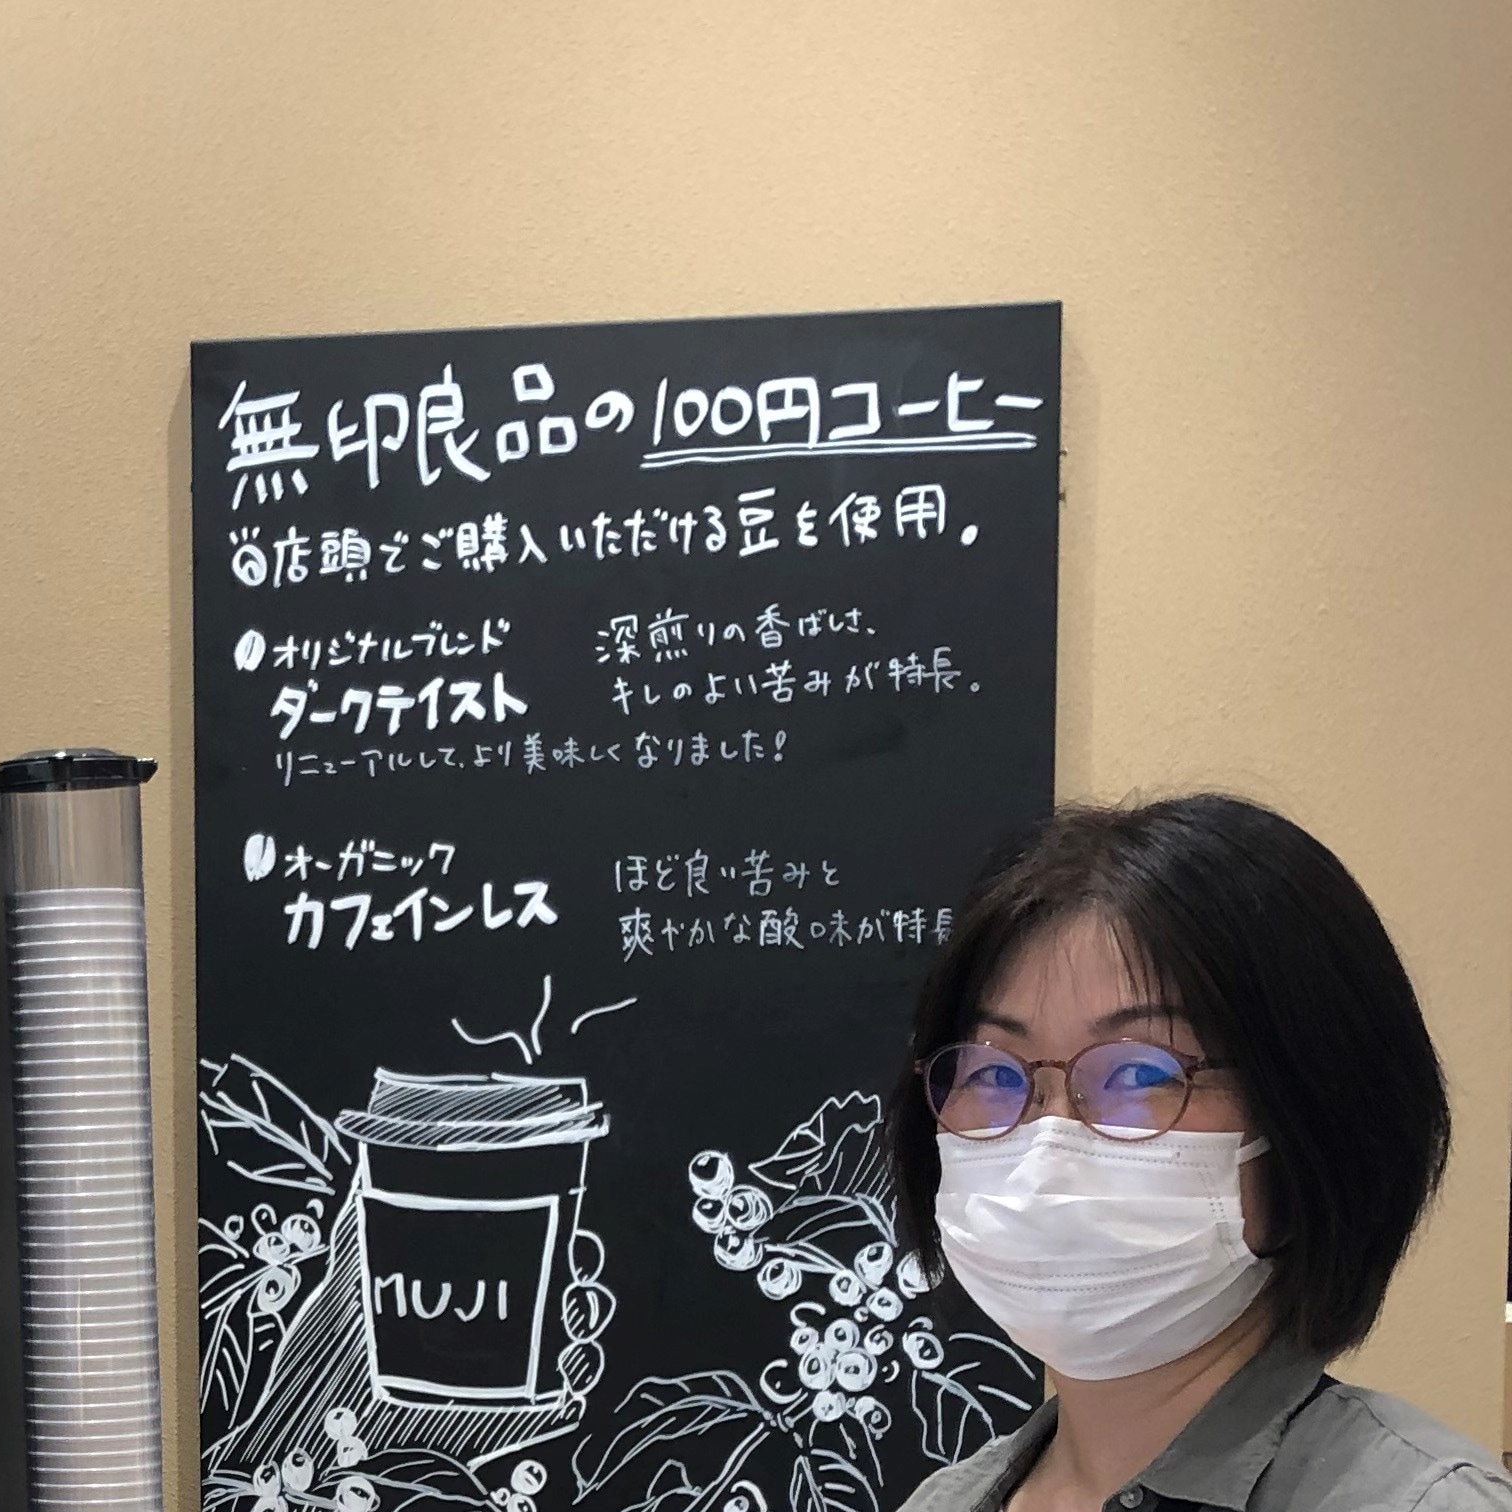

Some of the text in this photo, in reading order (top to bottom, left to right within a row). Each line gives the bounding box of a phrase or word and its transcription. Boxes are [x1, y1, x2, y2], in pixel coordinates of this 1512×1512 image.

[219, 363, 1043, 508] 無印良品の100円コーヒー
[272, 619, 511, 670] オリジナルブレンド
[270, 674, 528, 740] ダークテイスト
[285, 841, 457, 878] オーガニック
[285, 880, 559, 950] カフェインレス
[374, 1272, 508, 1323] MUJI
